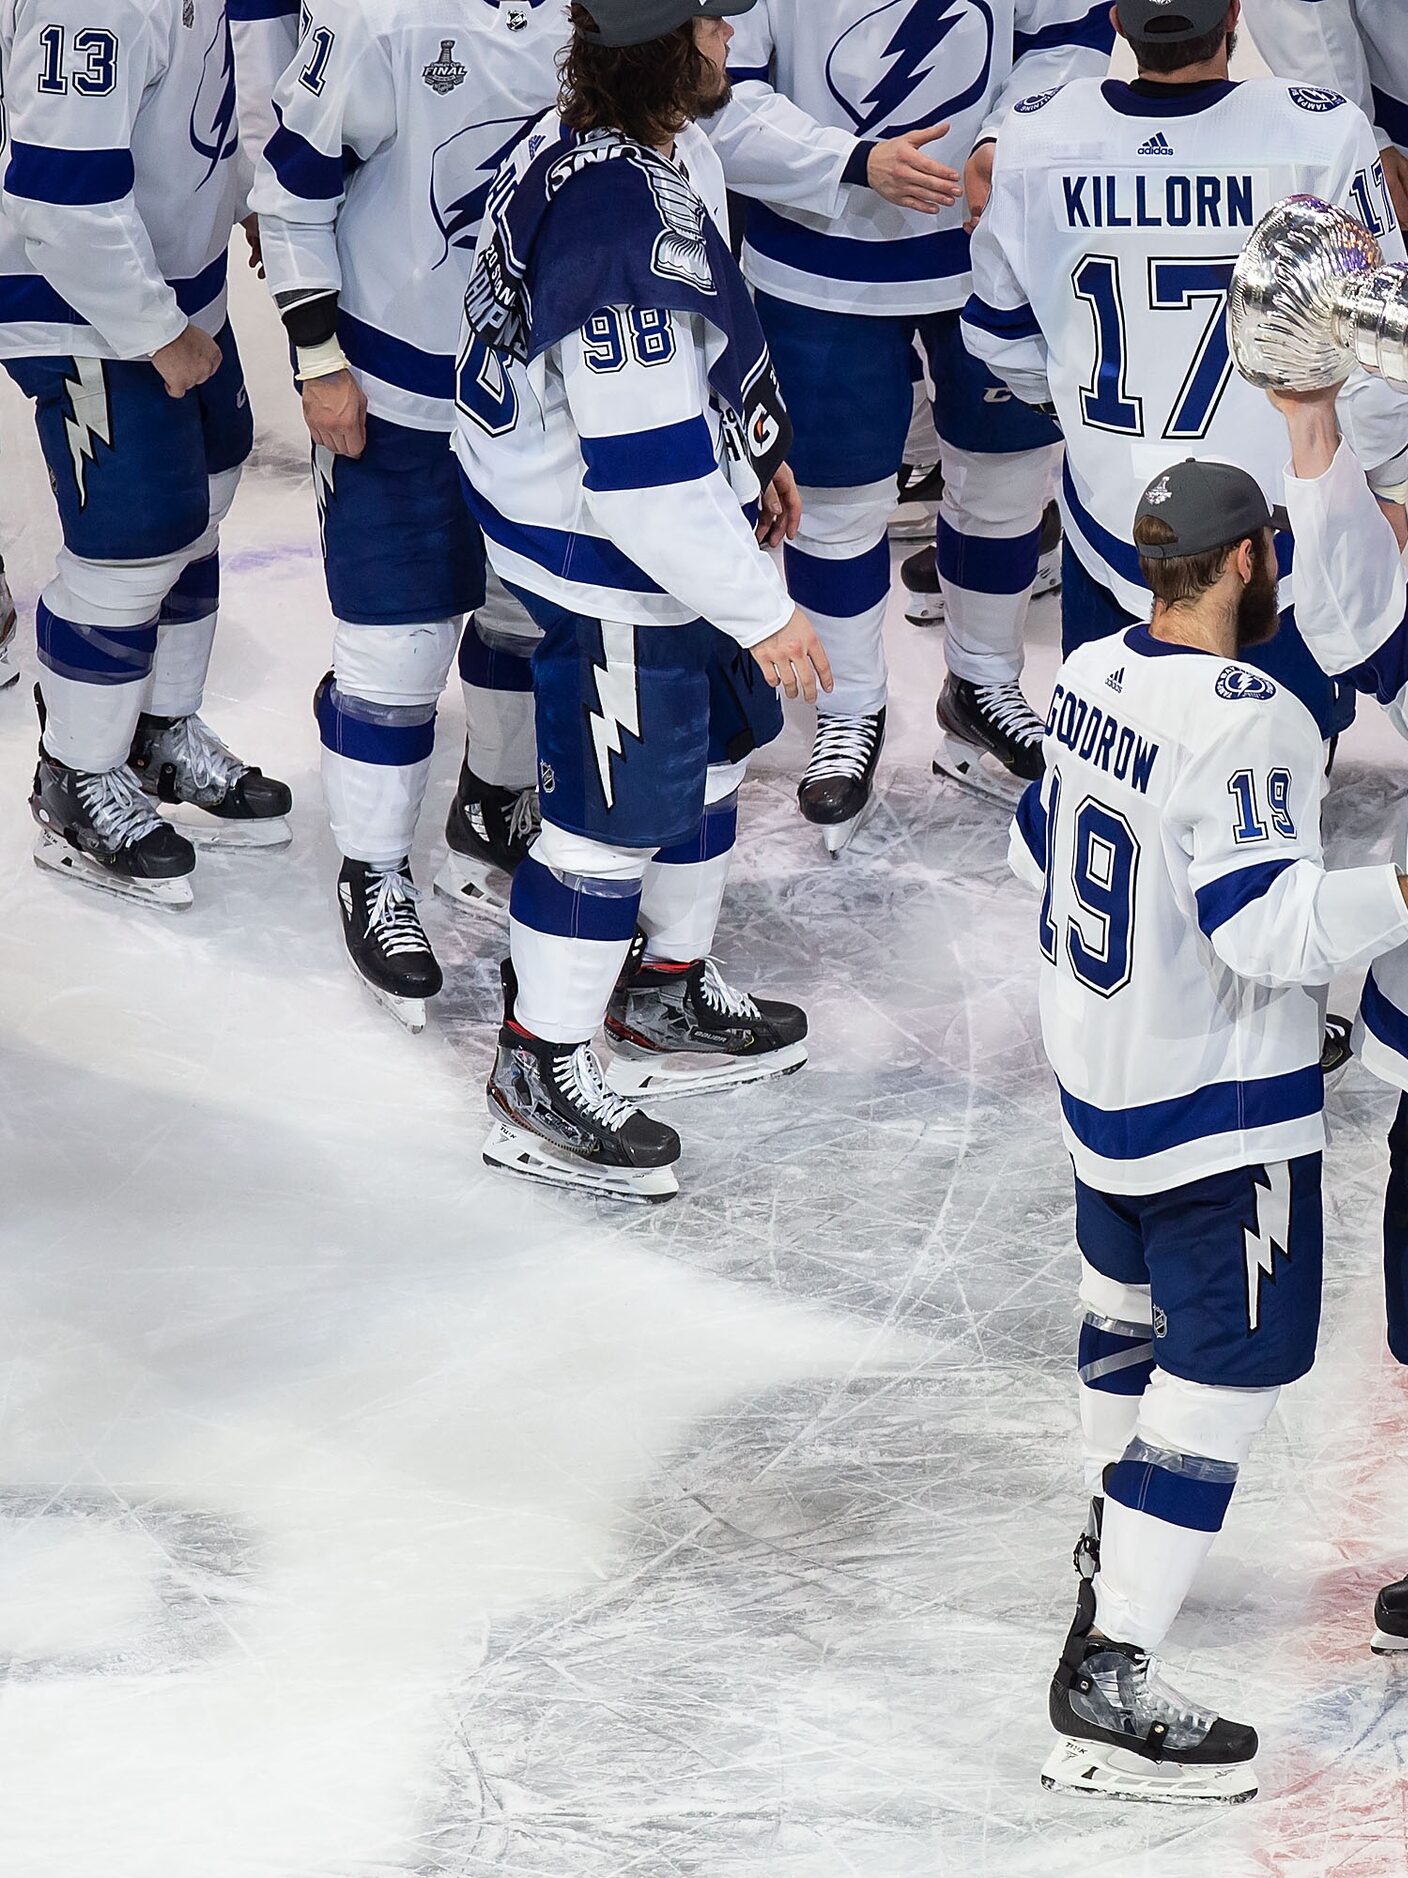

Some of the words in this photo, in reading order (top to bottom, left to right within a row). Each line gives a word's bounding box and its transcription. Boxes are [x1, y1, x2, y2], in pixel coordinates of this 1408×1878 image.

[38, 24, 118, 97] 13
[424, 66, 466, 76] FINAL
[1137, 146, 1174, 157] adidas
[1062, 175, 1255, 228] KILLORN
[1349, 156, 1397, 238] 17
[580, 304, 677, 374] 98
[1071, 253, 1240, 440] 17
[1227, 767, 1297, 845] 19
[1039, 764, 1142, 1000] 19
